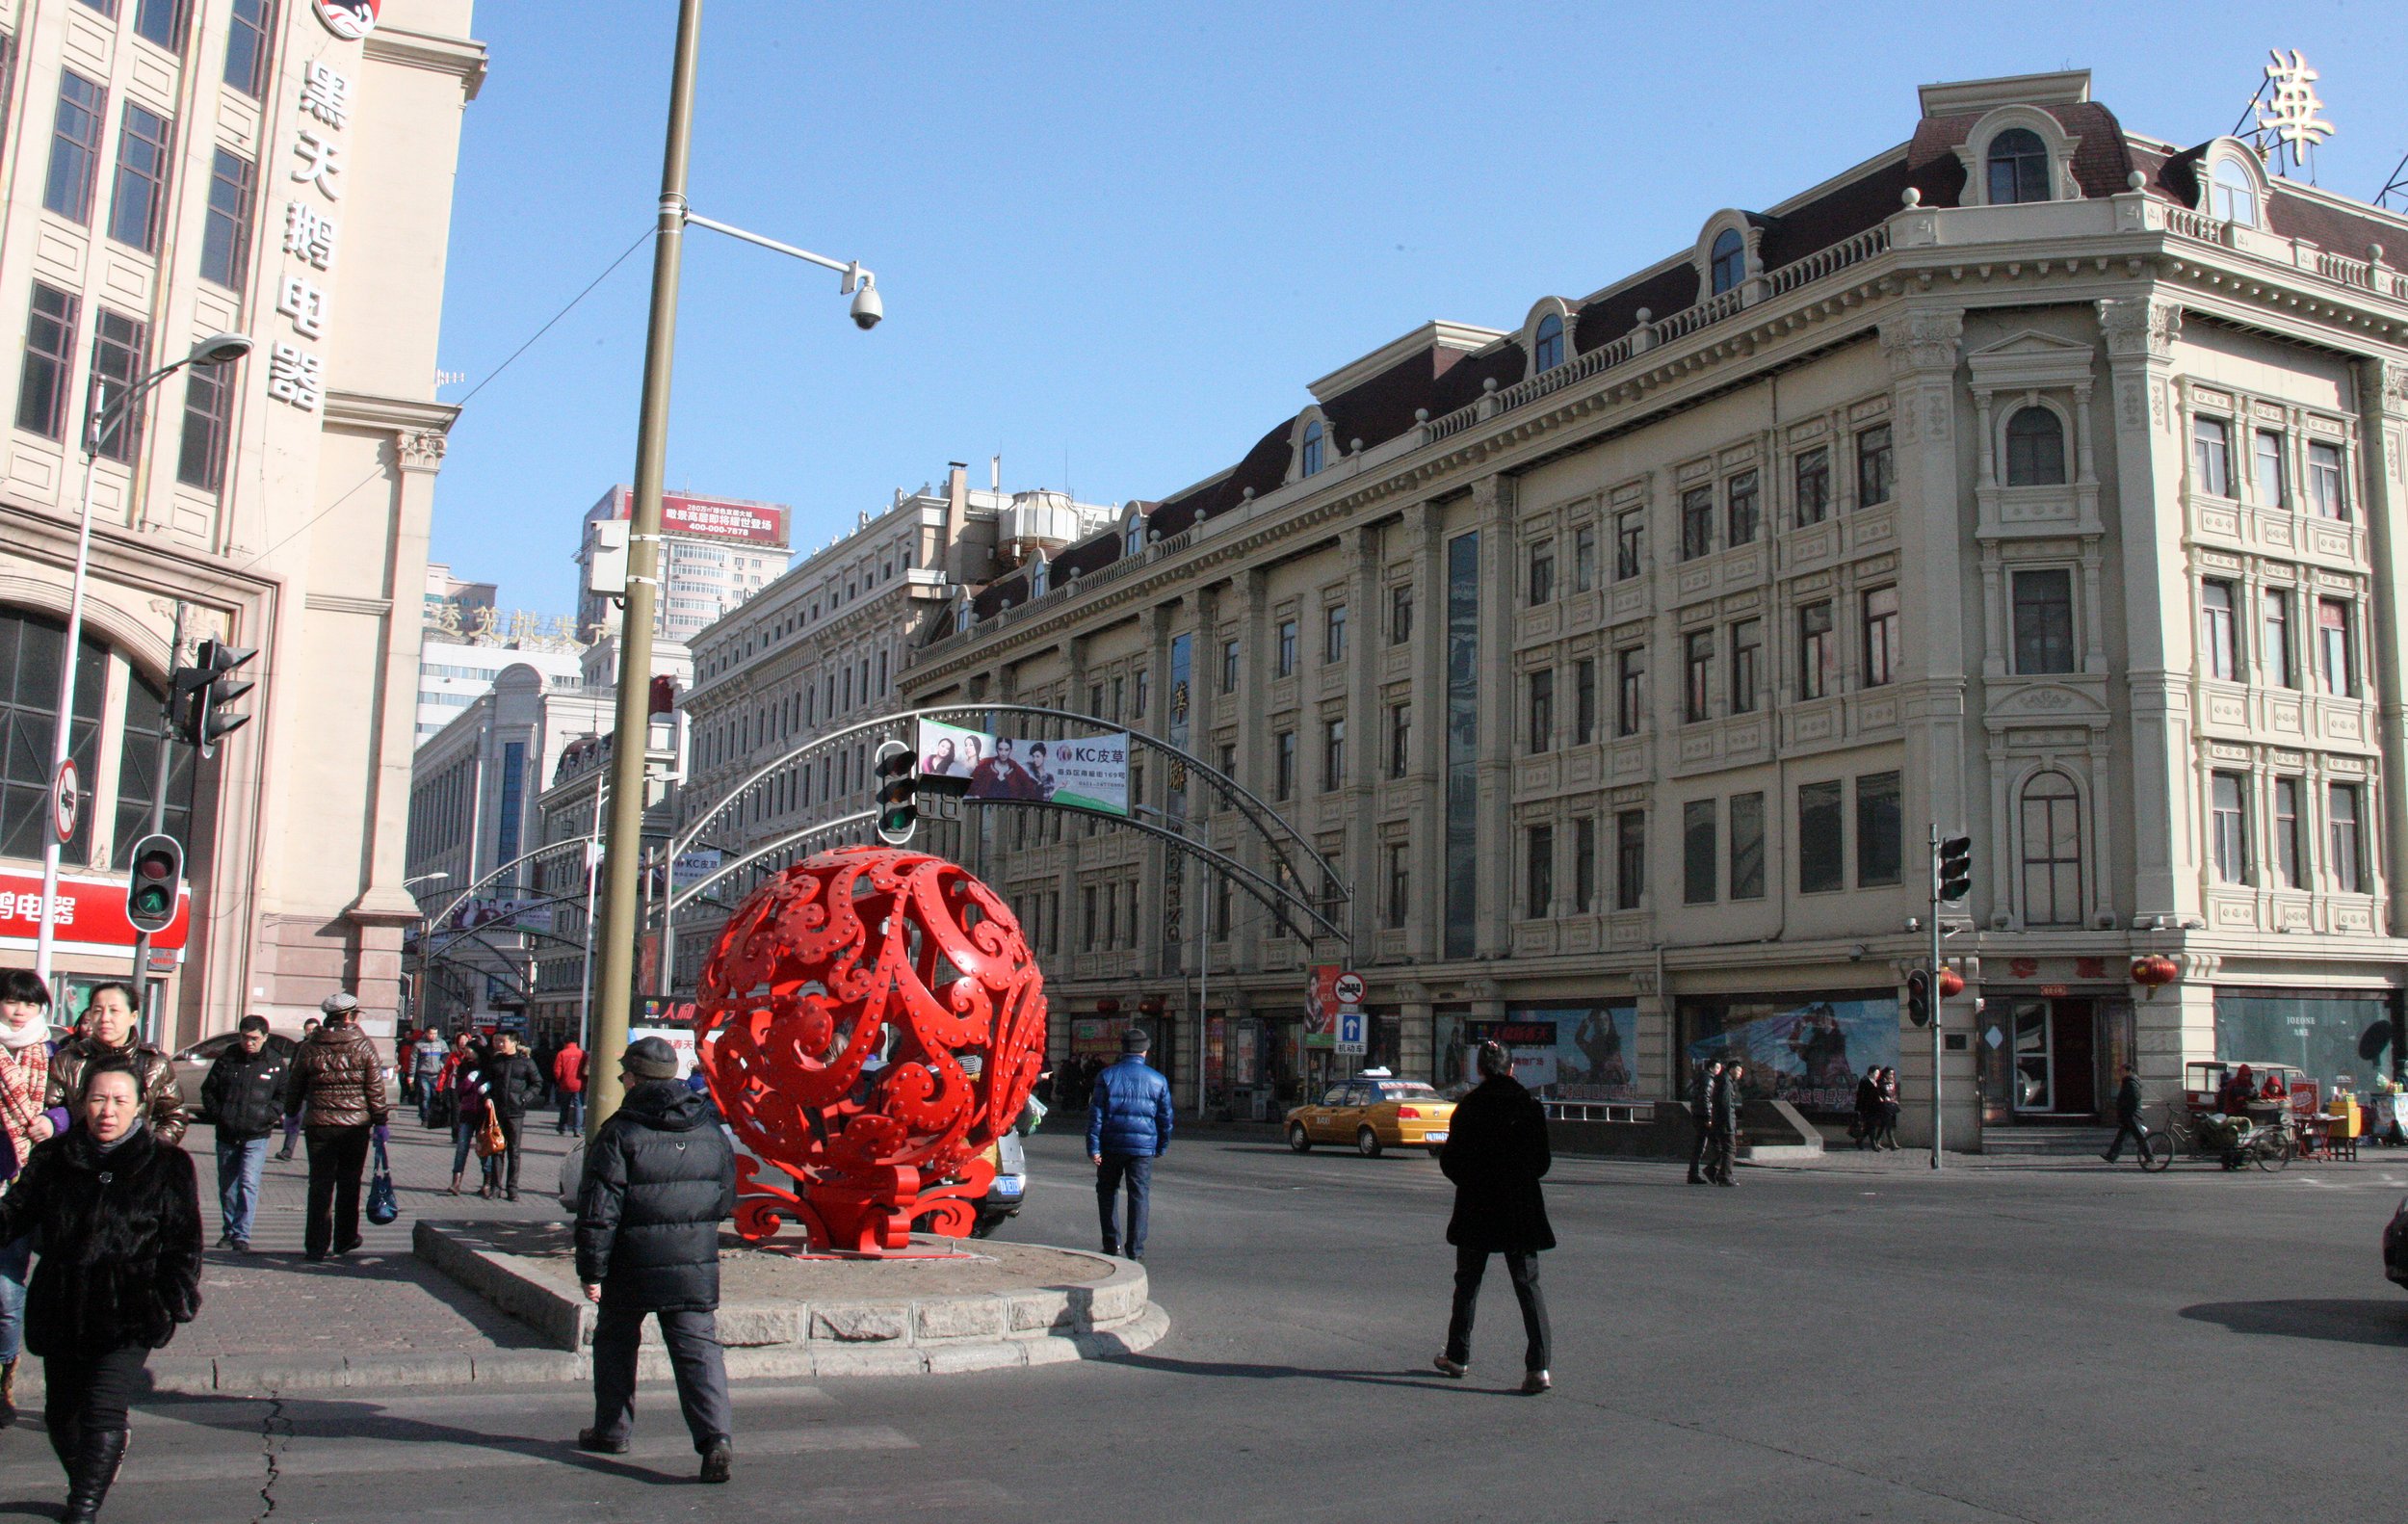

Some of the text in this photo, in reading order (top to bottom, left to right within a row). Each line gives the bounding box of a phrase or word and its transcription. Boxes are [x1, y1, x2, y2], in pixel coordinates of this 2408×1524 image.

[2260, 47, 2335, 167] 華
[269, 58, 353, 411] 黑天鹅电器
[689, 523, 748, 536] 400-000-7878
[1076, 748, 1124, 763] KC皮草
[2286, 1016, 2316, 1025] JOEONE
[1338, 1044, 1364, 1053] 机动车
